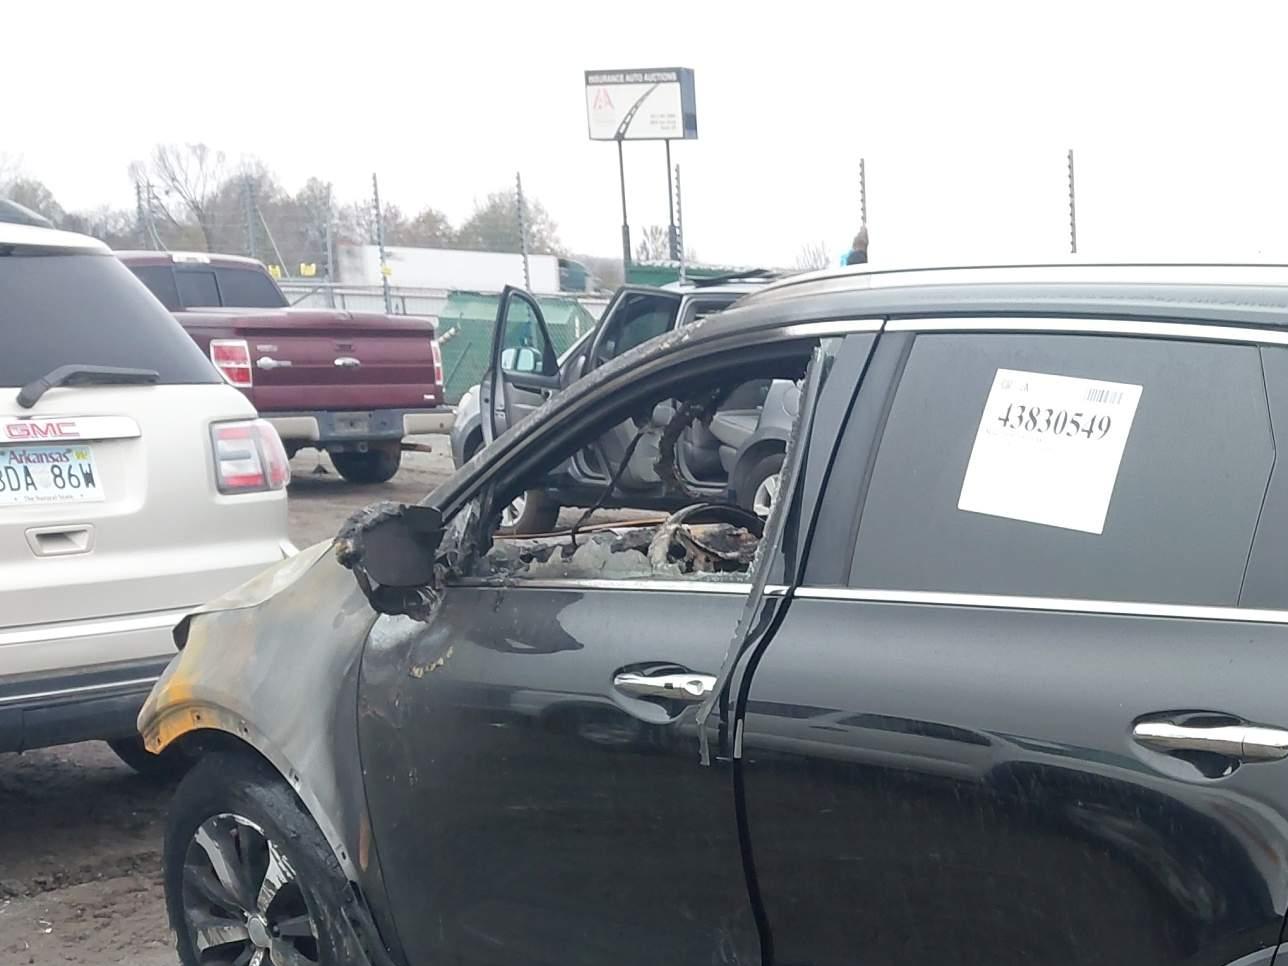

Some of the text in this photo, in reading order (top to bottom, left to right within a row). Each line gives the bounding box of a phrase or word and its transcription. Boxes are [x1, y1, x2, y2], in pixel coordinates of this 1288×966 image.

[6, 421, 80, 439] GMC
[998, 403, 1112, 440] 43830549
[9, 450, 70, 464] Arkansas
[50, 464, 96, 489] 86W
